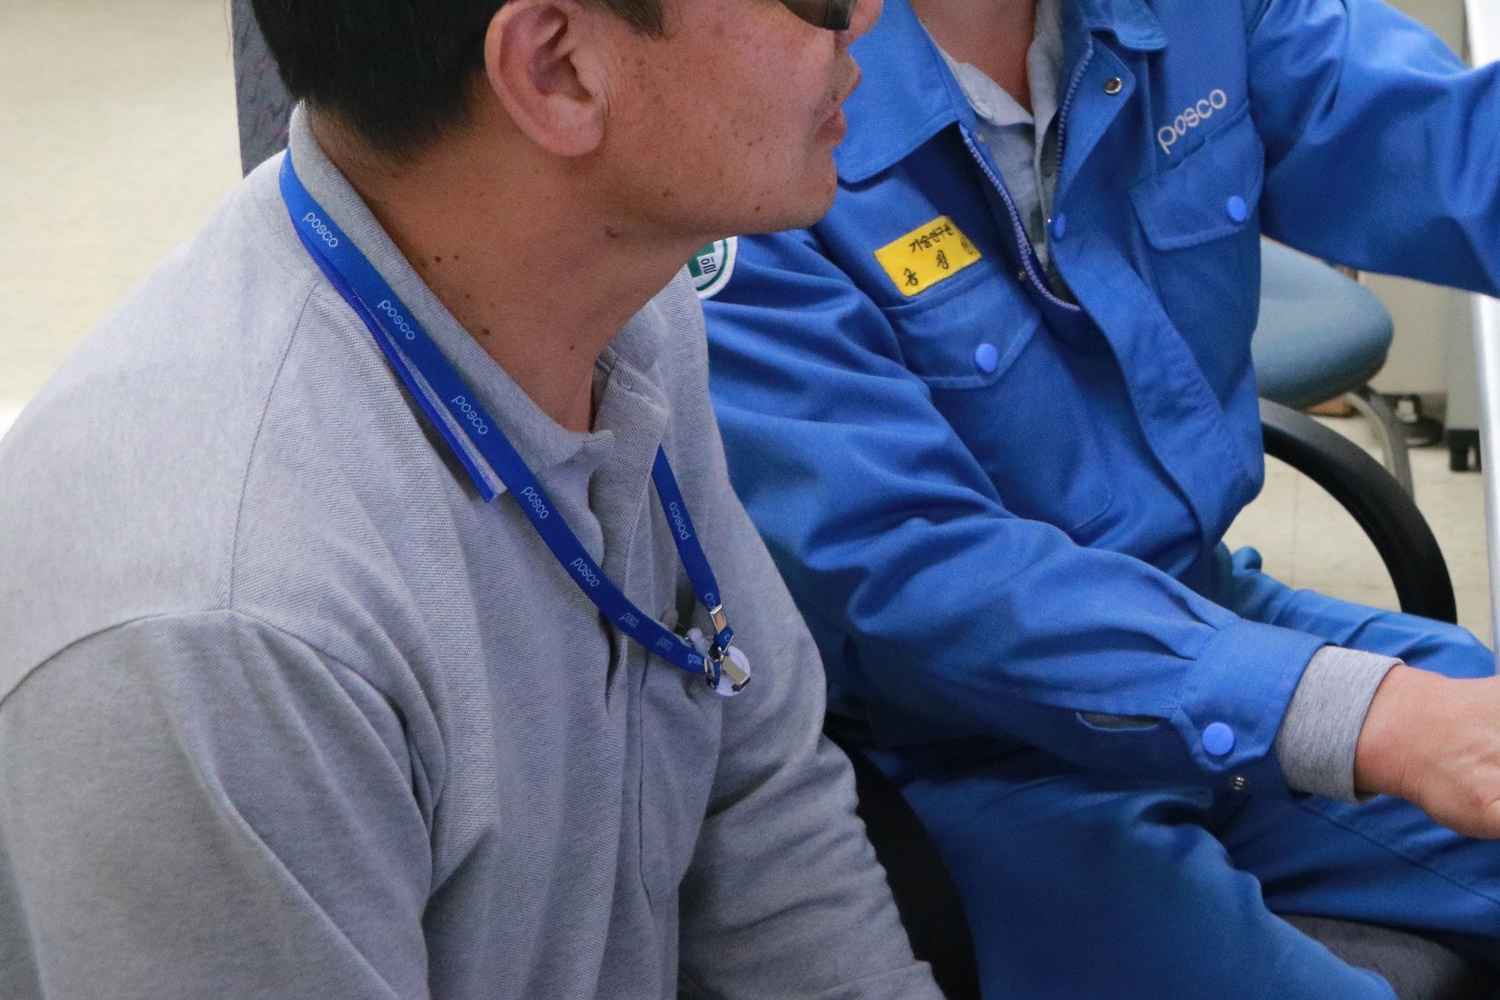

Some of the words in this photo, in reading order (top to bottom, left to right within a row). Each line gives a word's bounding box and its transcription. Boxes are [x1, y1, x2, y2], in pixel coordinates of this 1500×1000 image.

[1157, 89, 1227, 155] posco
[302, 212, 339, 248] posco
[377, 300, 416, 341] posco
[451, 395, 489, 435] posco
[520, 486, 549, 520] posco
[669, 502, 691, 541] posco
[570, 557, 600, 587] posco
